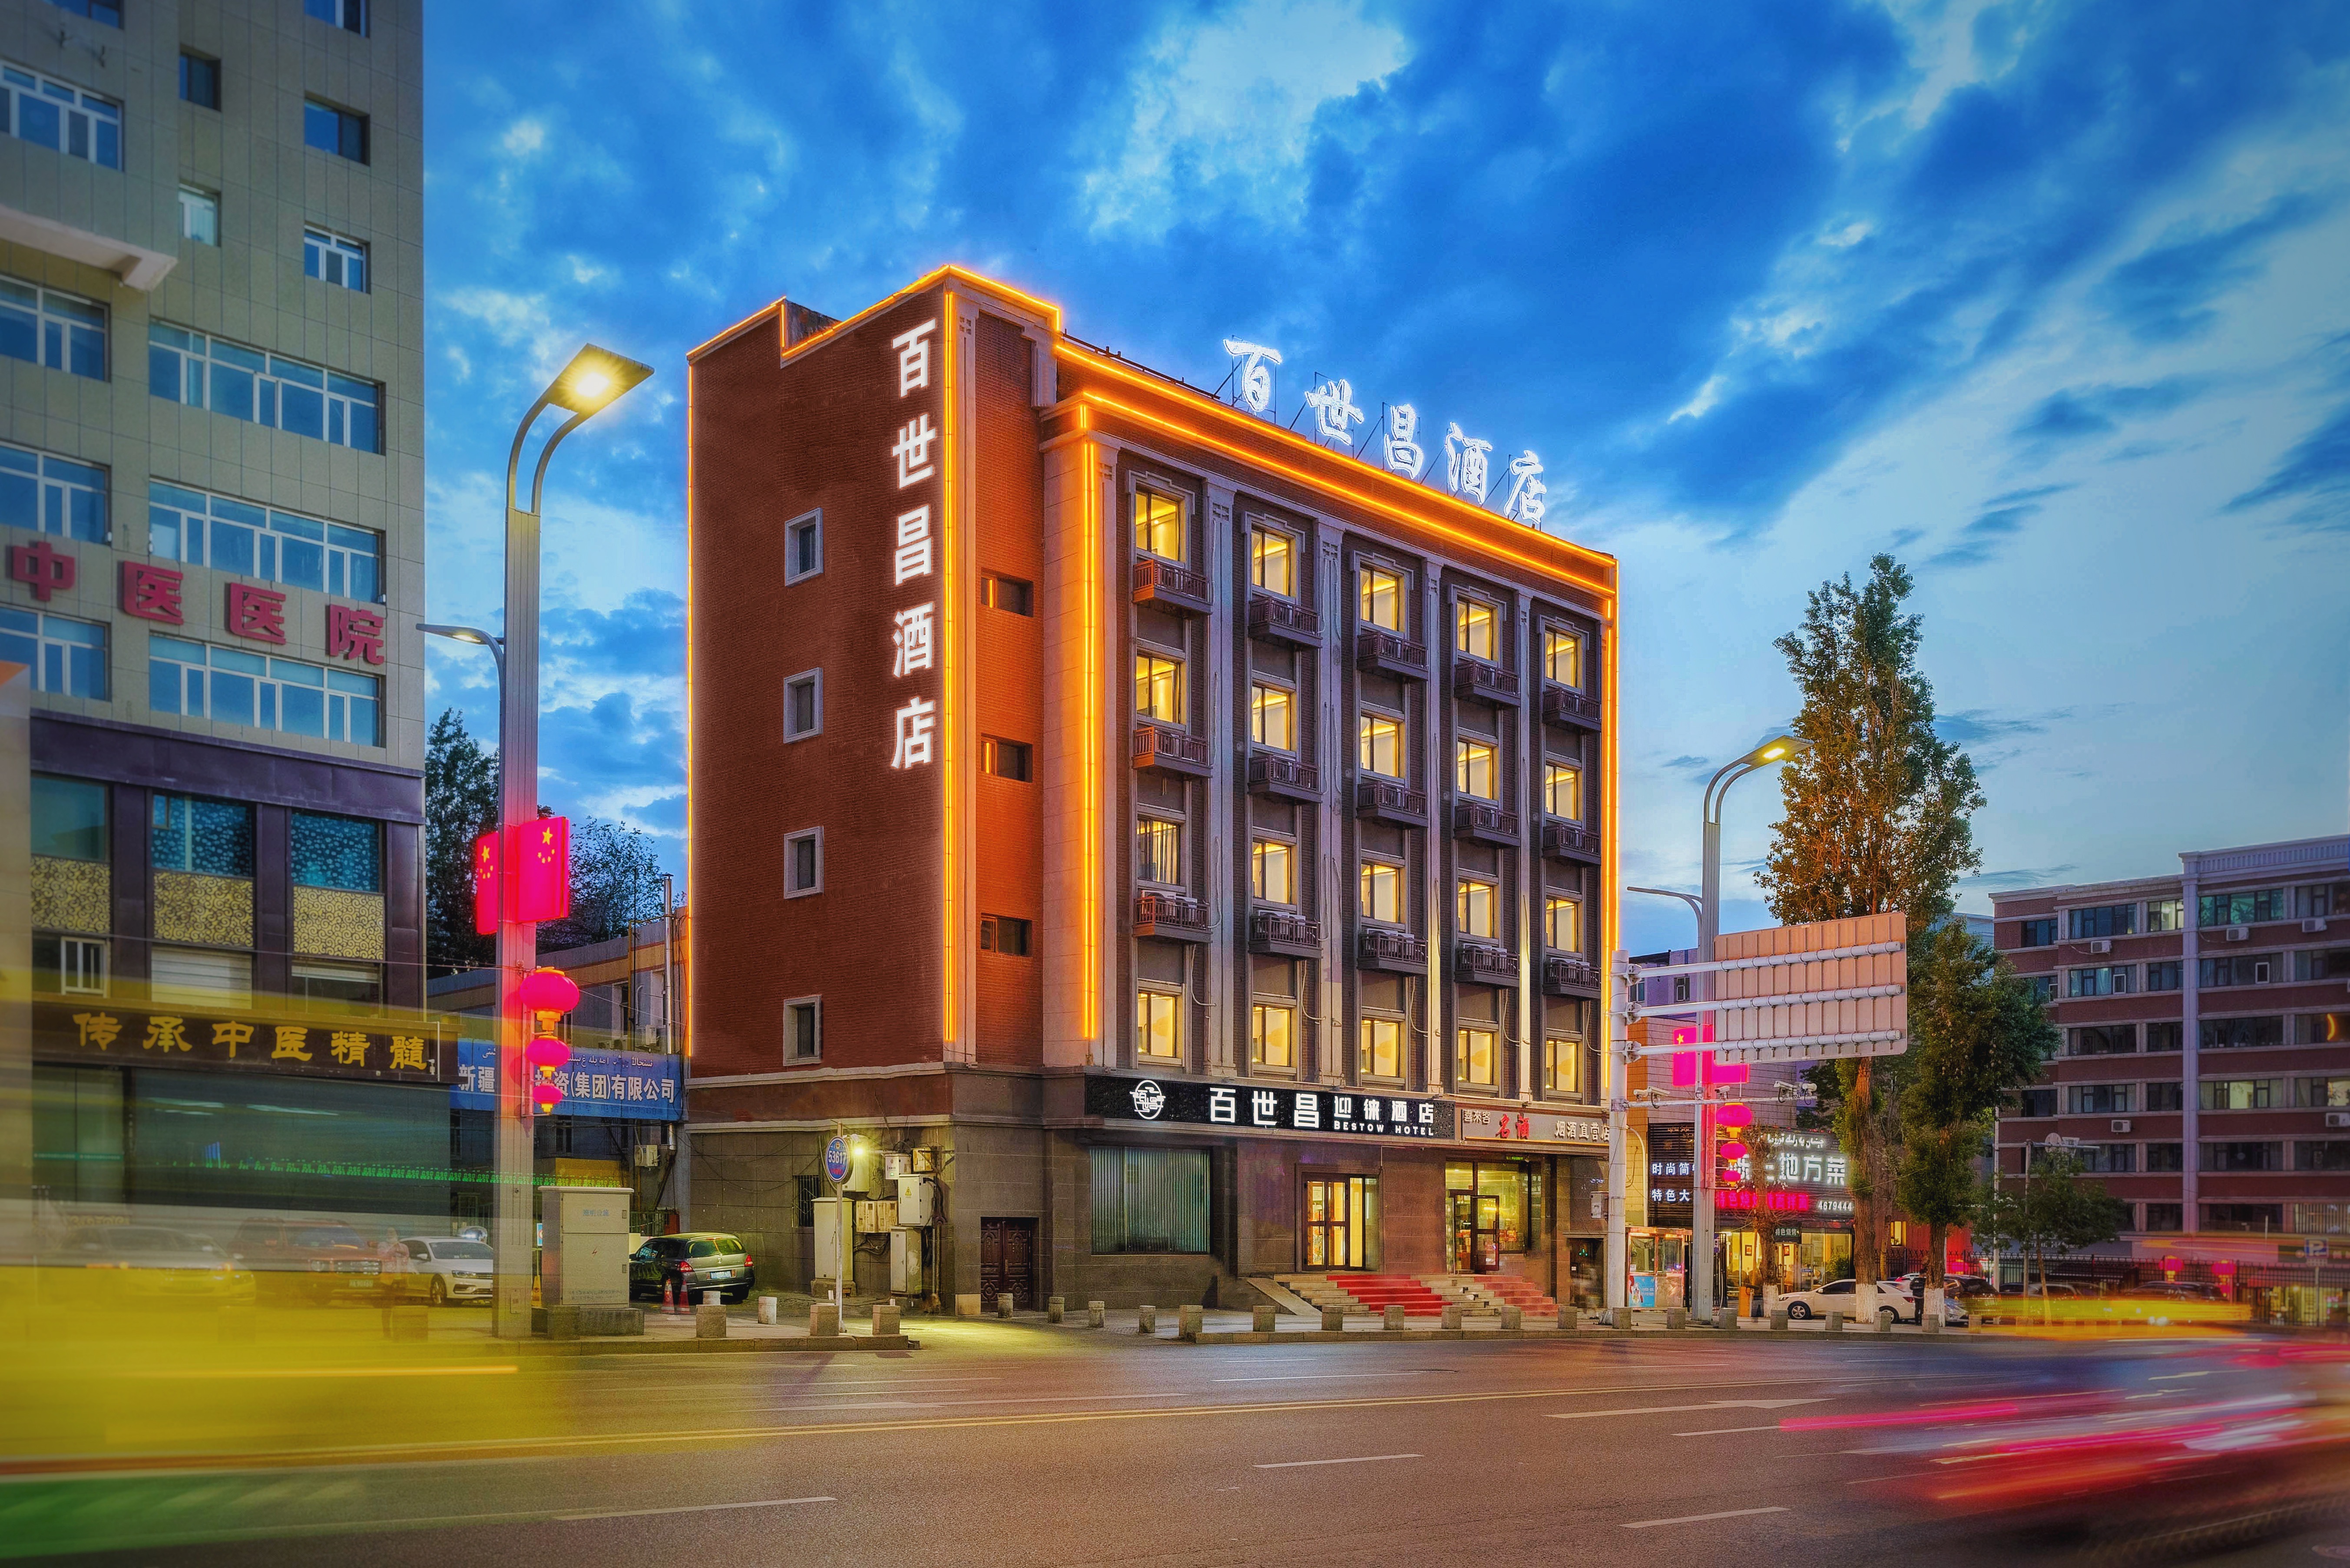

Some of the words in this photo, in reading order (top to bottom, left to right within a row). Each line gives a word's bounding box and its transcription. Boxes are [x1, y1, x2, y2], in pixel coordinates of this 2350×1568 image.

[1223, 338, 1548, 524] 百世昌酒店
[891, 318, 936, 769] 百世昌酒店
[13, 542, 385, 665] 中医医院
[73, 1012, 427, 1069] 传承中医精髓
[1334, 1120, 1384, 1133] BESTOW
[1395, 1125, 1433, 1136] HOTEL
[1556, 1120, 1610, 1142] 烟酒直营店
[828, 1151, 846, 1164] 53617
[1652, 1188, 1690, 1202] 特色大
[1817, 1201, 1852, 1211] 4679444
[2309, 1240, 2324, 1256] P
